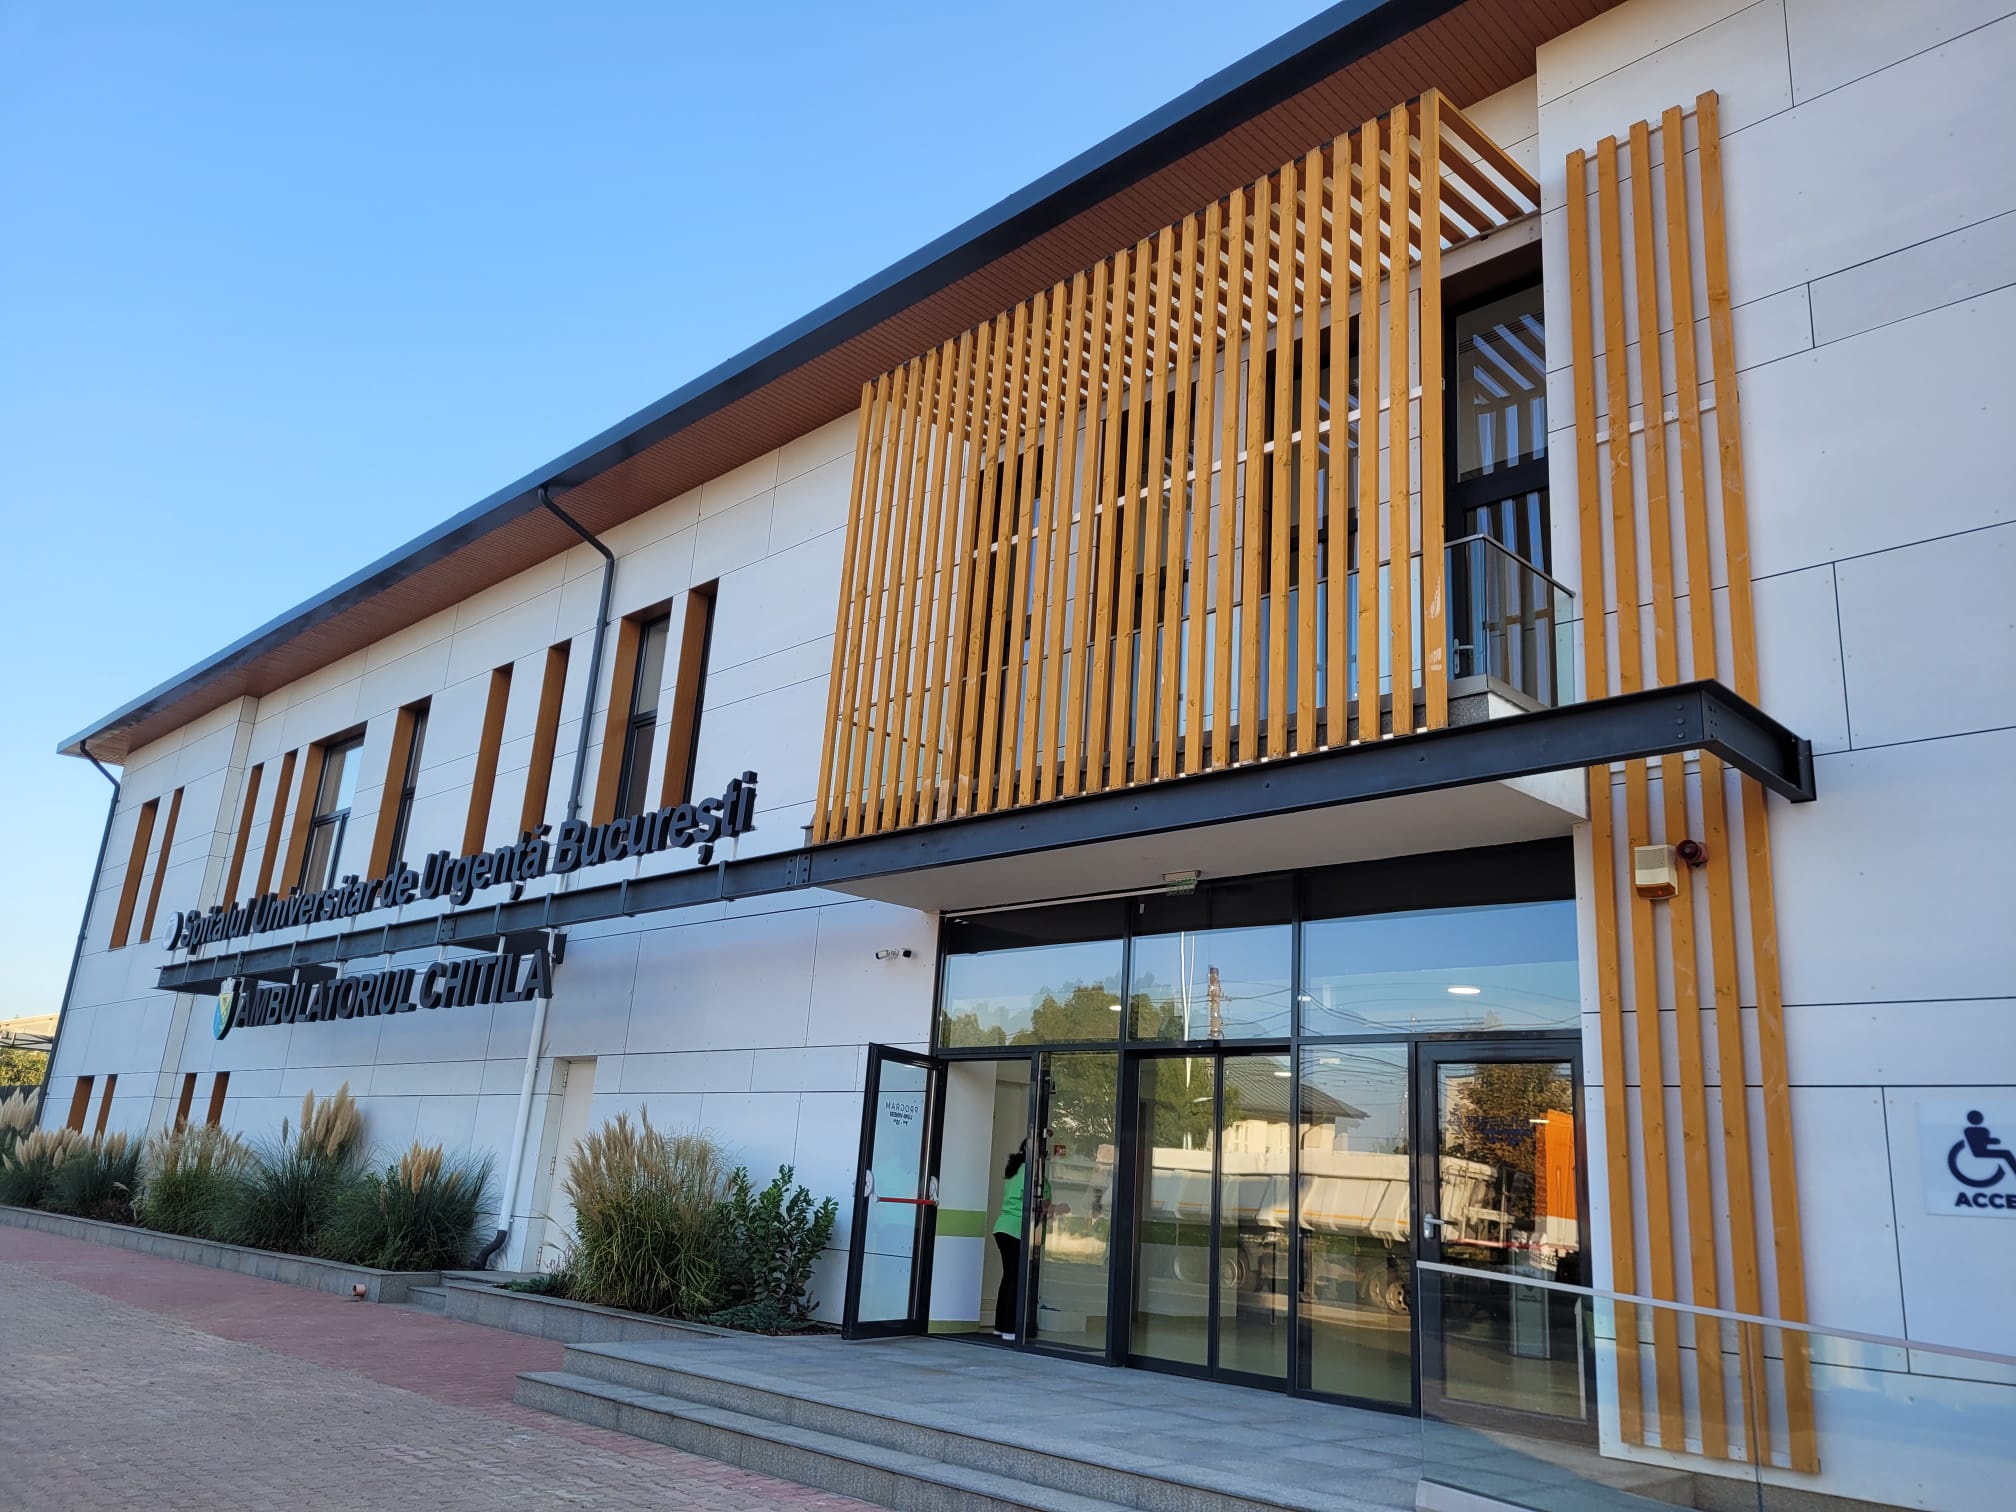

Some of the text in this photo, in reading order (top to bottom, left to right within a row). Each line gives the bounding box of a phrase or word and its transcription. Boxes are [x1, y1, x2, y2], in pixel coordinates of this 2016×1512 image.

[180, 771, 758, 955] Spitalul Universitar de Urgență București
[234, 947, 552, 1027] AMBULATORIUL CHITILA
